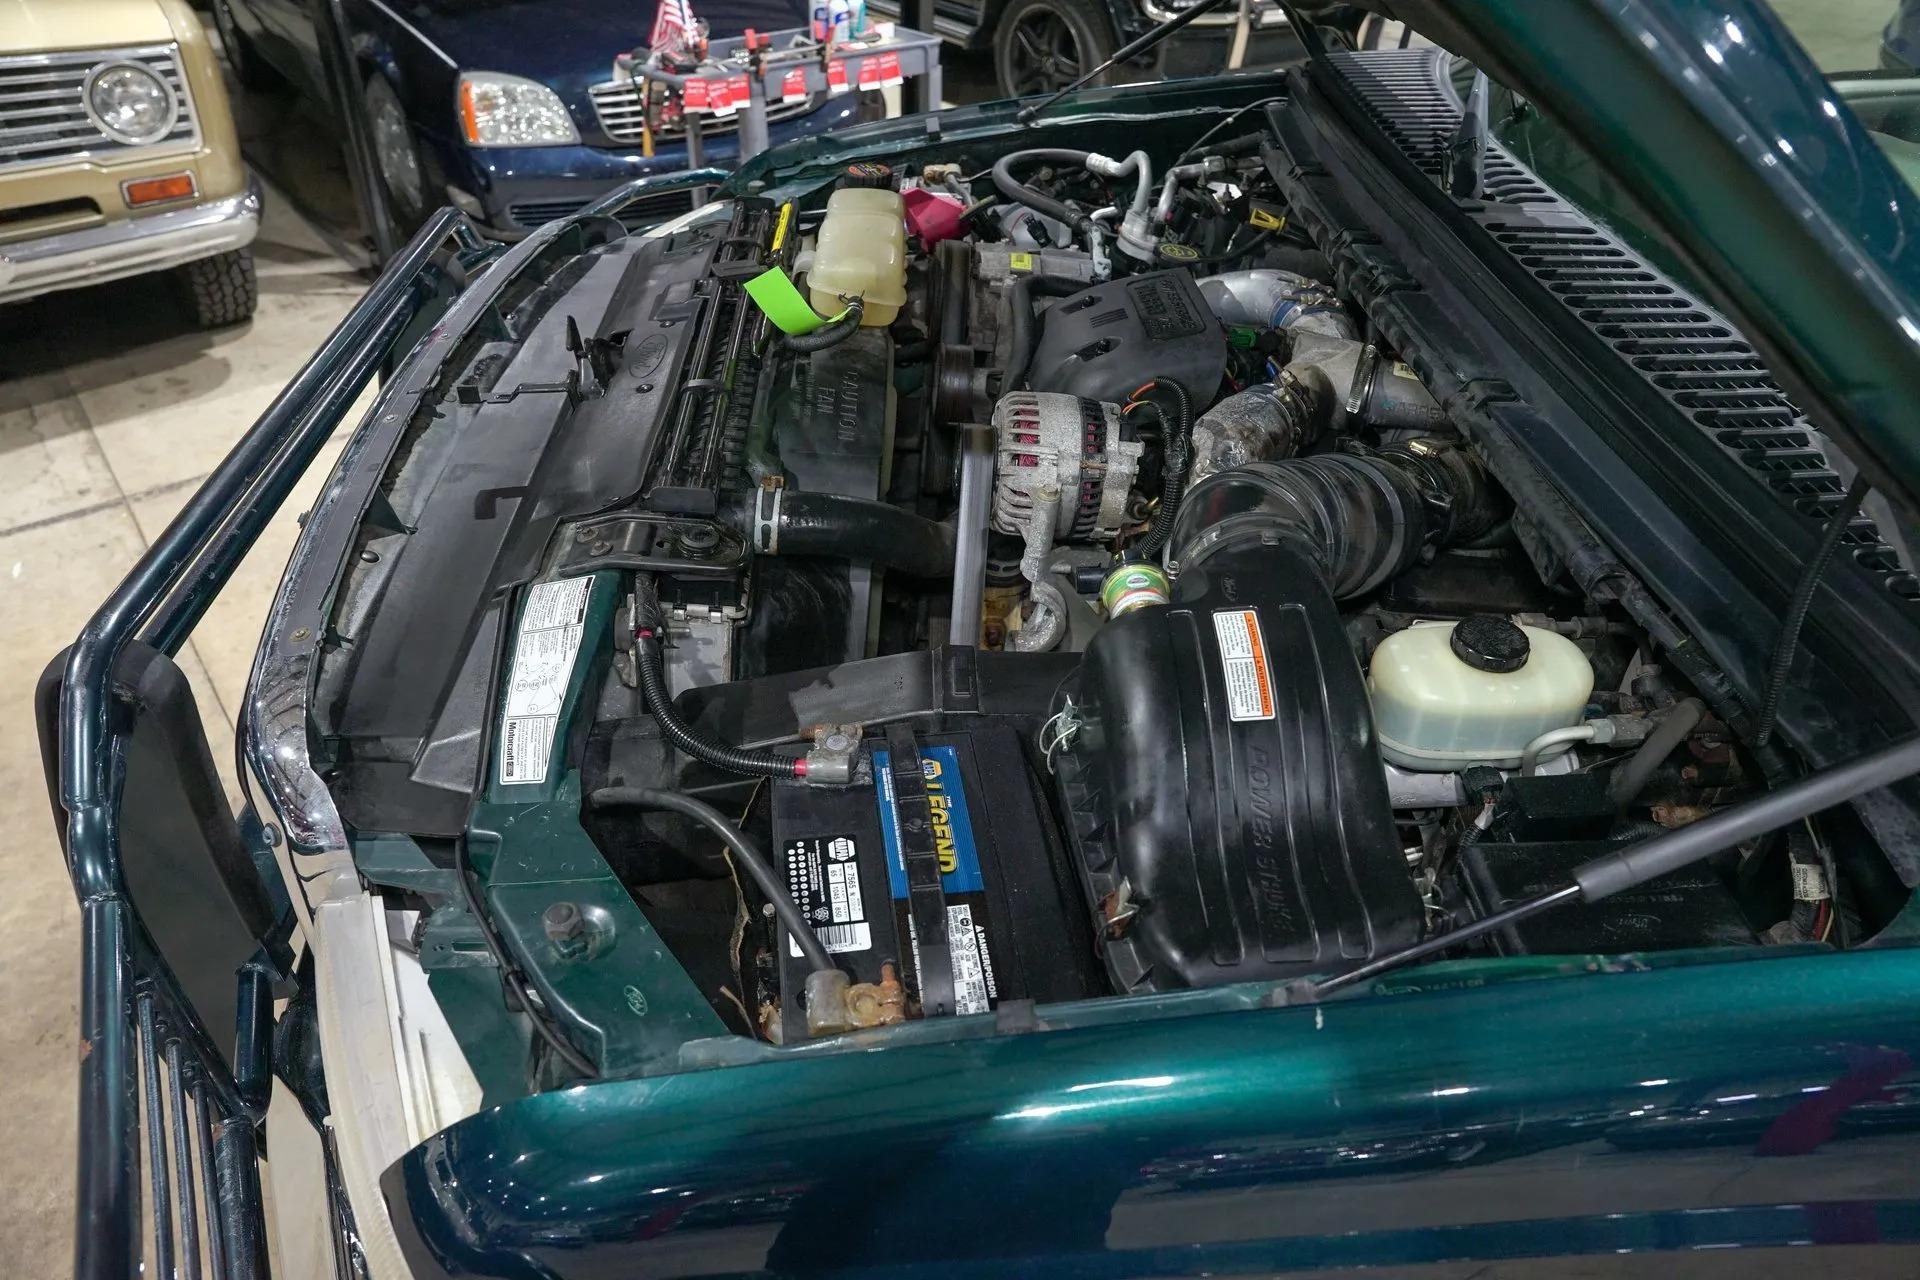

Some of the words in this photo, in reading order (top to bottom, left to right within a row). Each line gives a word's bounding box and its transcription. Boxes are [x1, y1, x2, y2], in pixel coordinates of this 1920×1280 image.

[816, 386, 836, 415] FAN
[837, 369, 859, 441] CAUTION
[1248, 623, 1259, 647] WARNING
[1257, 665, 1270, 713] AVERTISSEMENT
[505, 721, 517, 761] Motorcraft
[945, 796, 953, 808] THE
[1247, 745, 1273, 849] POWER
[835, 840, 849, 860] NAPA
[830, 869, 838, 877] 65
[847, 872, 856, 889] 7565
[834, 906, 843, 918] 850
[977, 932, 998, 999] DANGER/POISON
